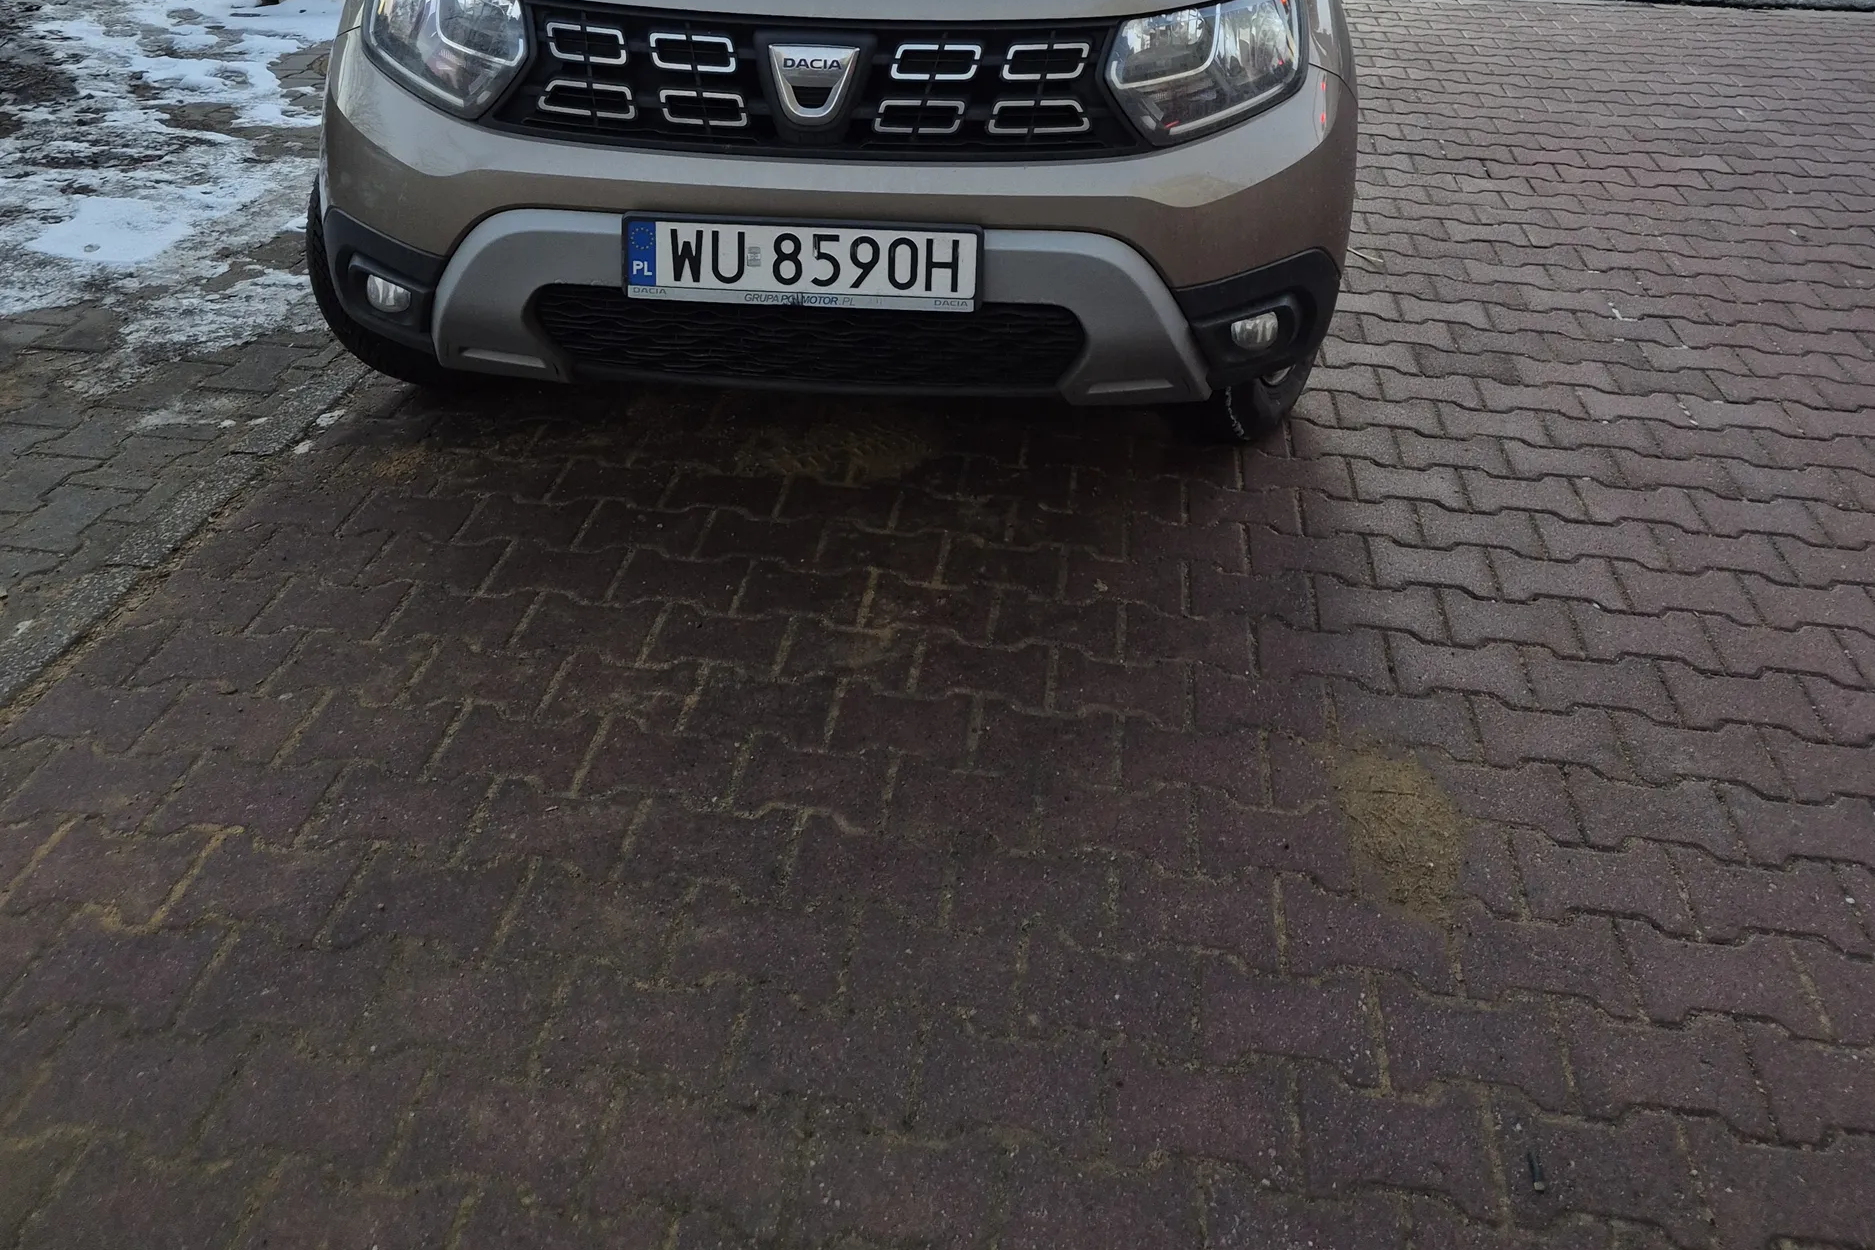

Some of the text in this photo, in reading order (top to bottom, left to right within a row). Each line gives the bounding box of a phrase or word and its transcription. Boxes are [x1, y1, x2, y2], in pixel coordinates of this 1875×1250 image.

[783, 57, 842, 70] DACIA
[670, 228, 960, 293] WU 8590H
[632, 260, 653, 277] PL
[633, 287, 667, 296] DACIA
[934, 299, 968, 307] DACIA
